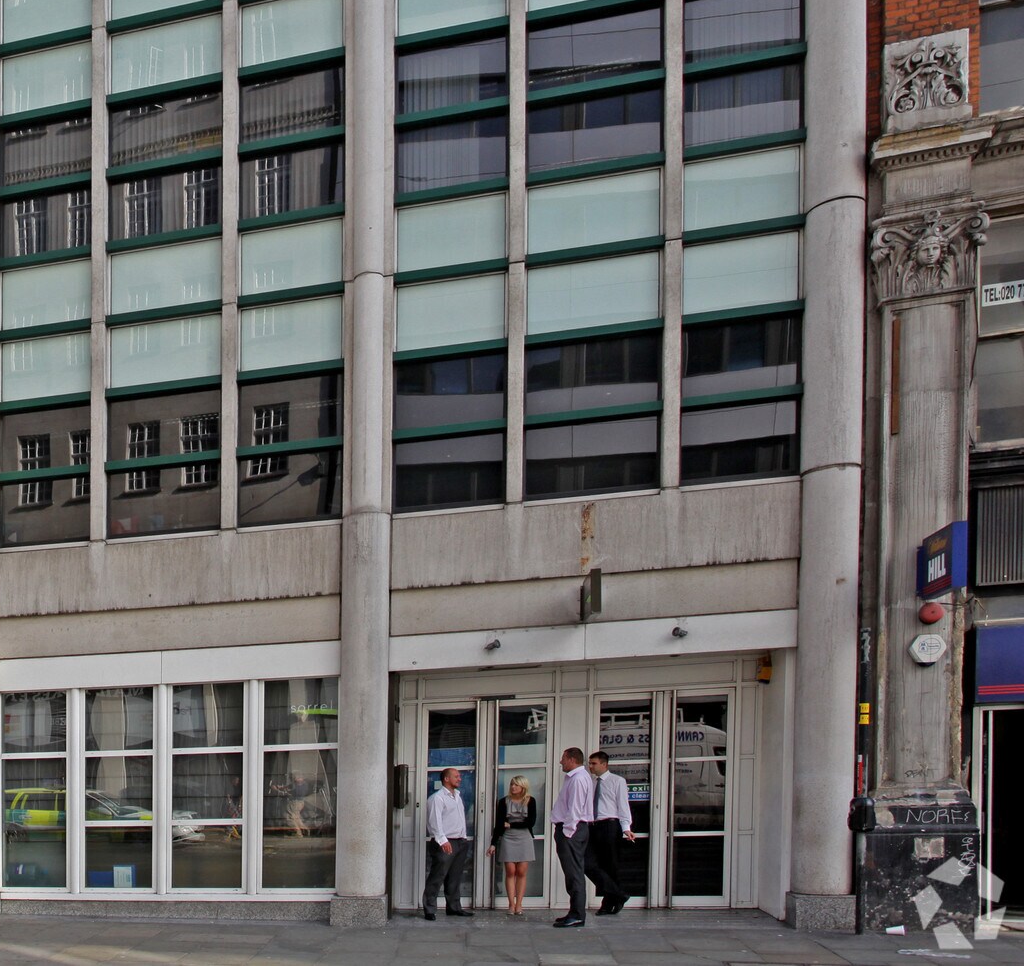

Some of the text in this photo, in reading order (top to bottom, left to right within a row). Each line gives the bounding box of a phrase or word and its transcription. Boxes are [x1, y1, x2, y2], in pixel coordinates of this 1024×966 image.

[984, 283, 1024, 302] TEL:020 7
[927, 553, 947, 583] HILL
[290, 699, 333, 713] sorrel
